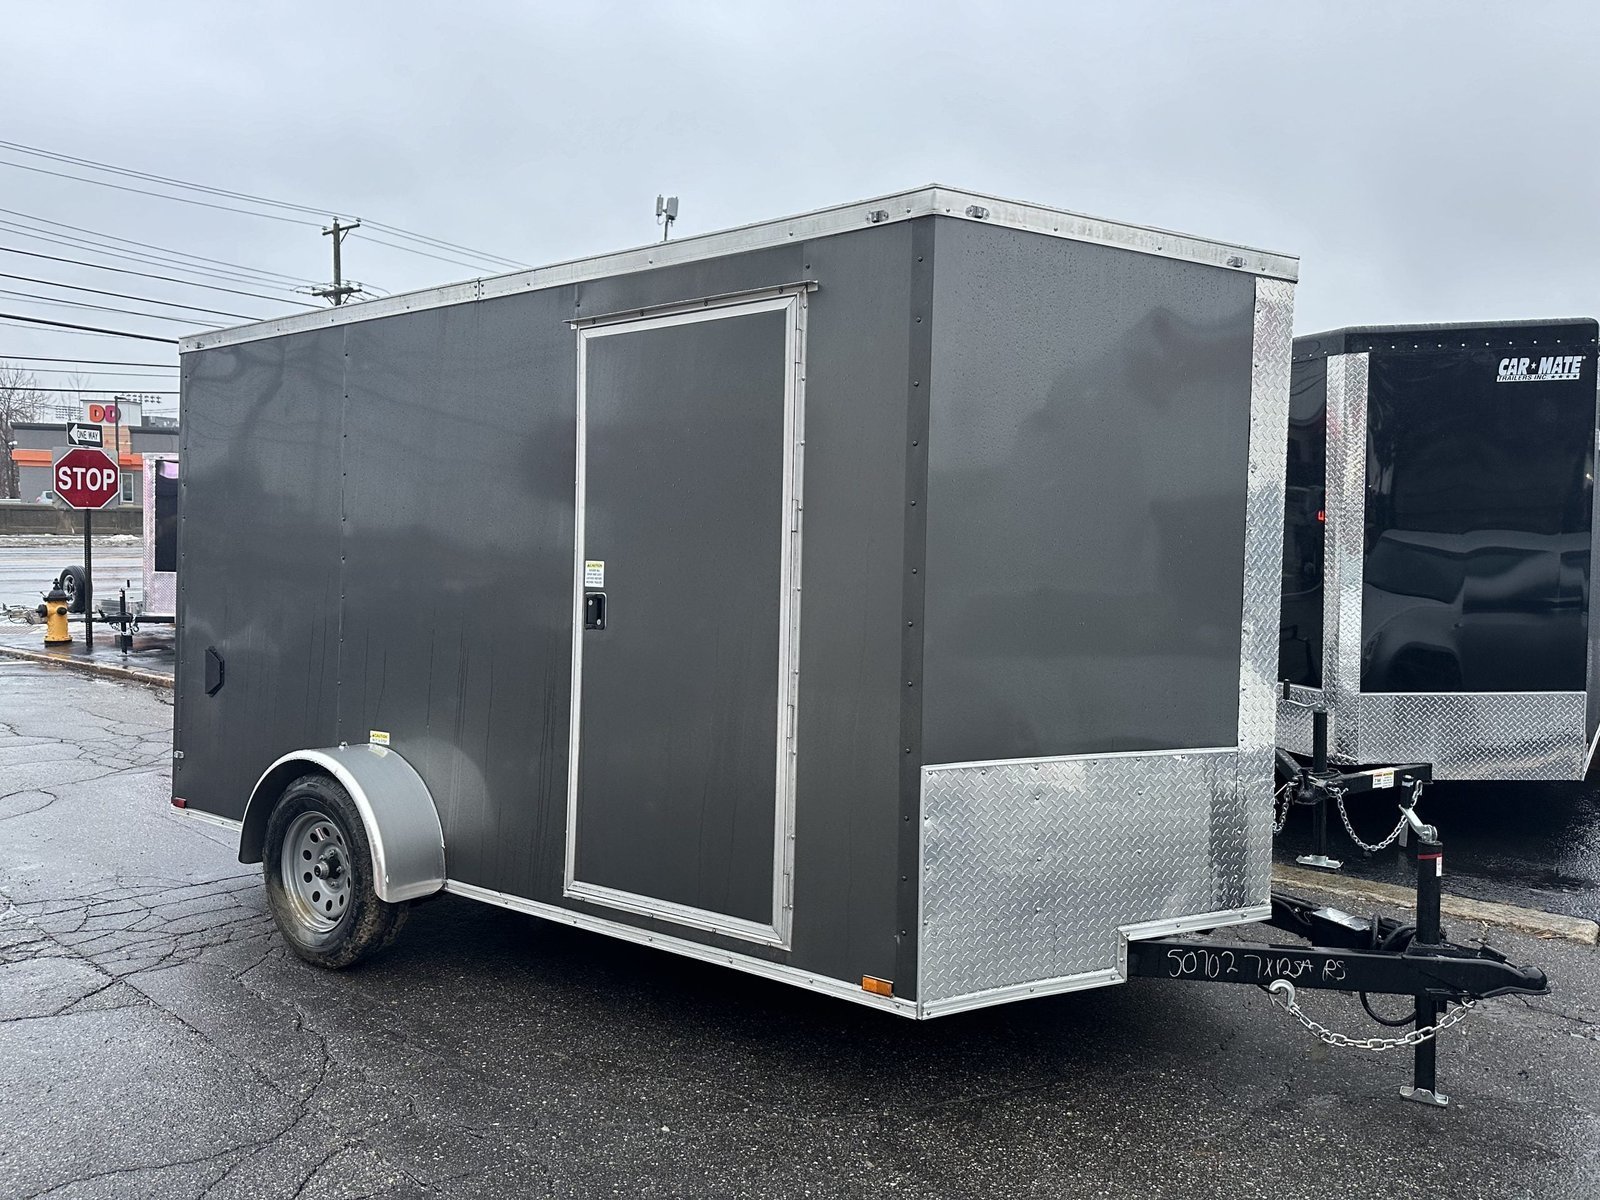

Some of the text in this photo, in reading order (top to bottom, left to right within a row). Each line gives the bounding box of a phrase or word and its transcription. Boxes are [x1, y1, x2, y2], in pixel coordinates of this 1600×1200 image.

[1498, 356, 1582, 375] CAR MATE
[1498, 374, 1532, 382] TRAILERS
[77, 429, 98, 440] ONE WAY
[58, 466, 116, 491] STOP
[1167, 949, 1239, 978] 50702
[1322, 959, 1347, 982] RS
